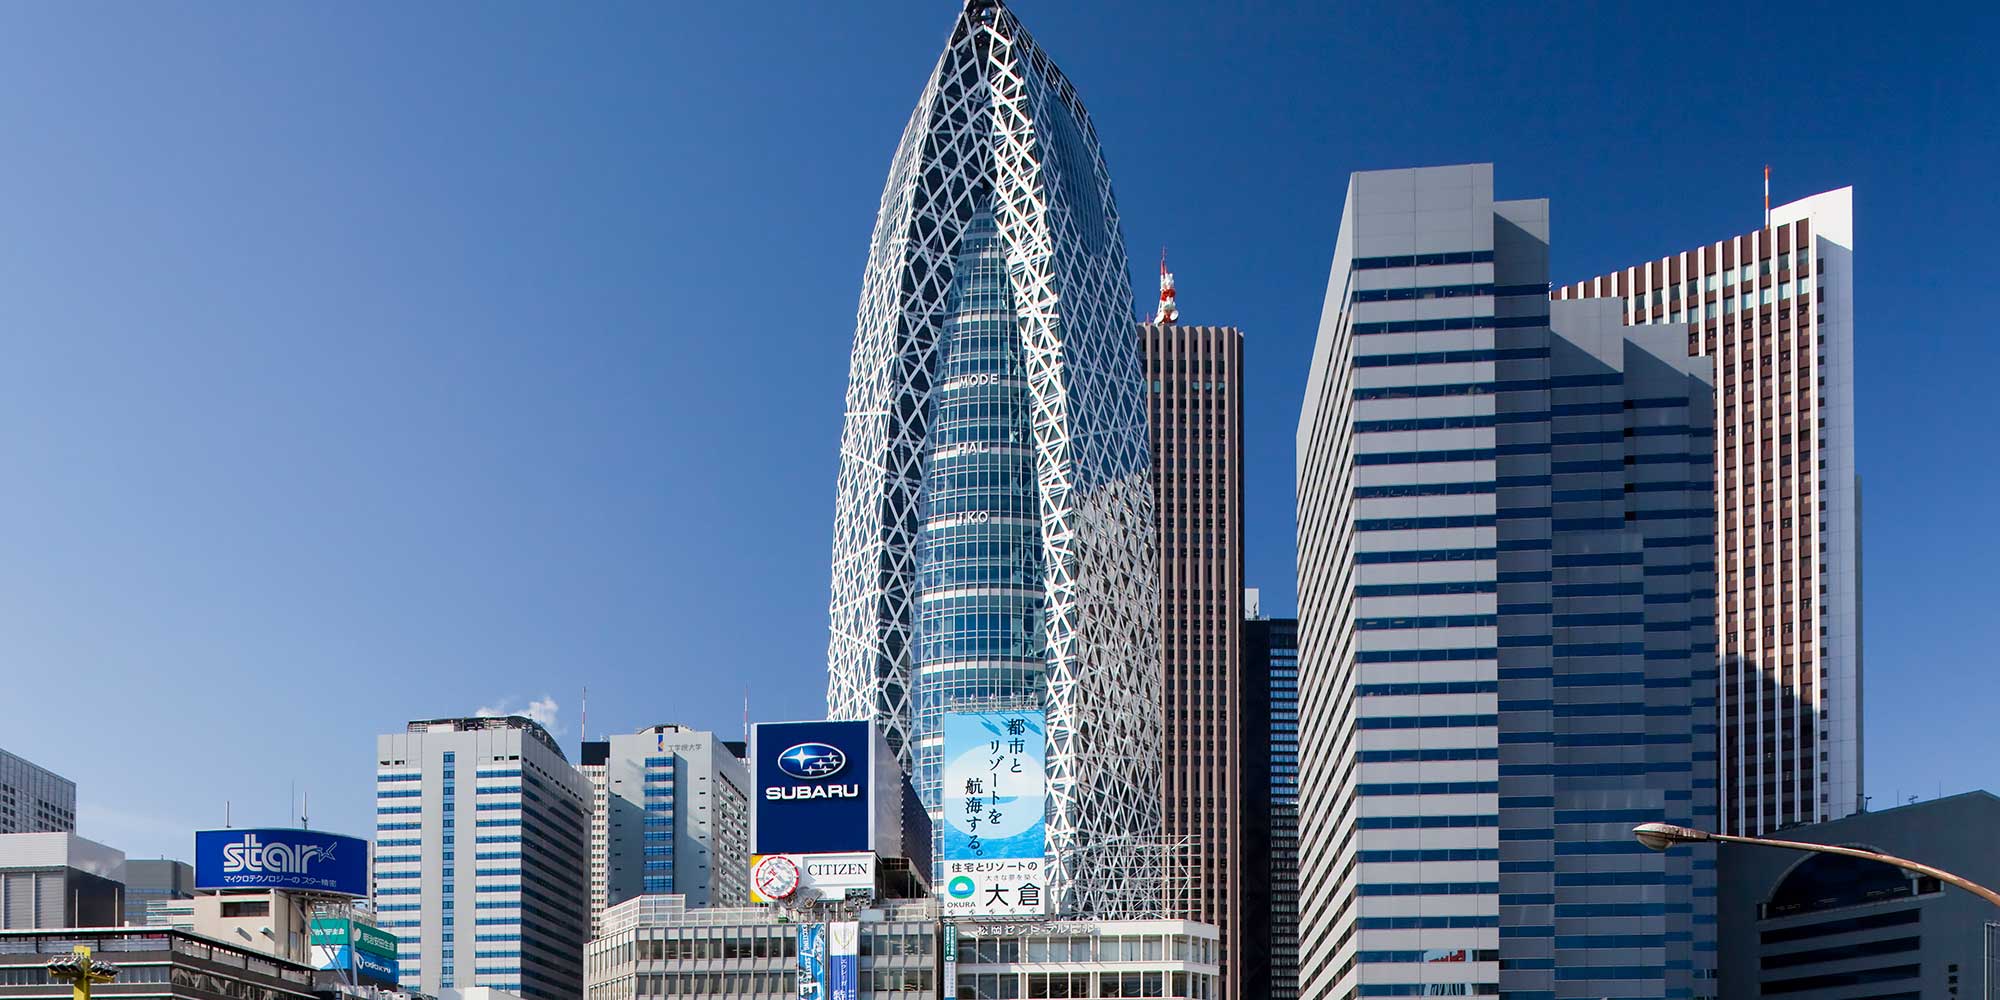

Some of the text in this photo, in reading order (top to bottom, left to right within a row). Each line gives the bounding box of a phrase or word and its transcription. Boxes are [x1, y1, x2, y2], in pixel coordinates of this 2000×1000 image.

[959, 373, 999, 388] MODE
[958, 441, 989, 456] HAL
[1008, 718, 1026, 773] 都市と
[765, 783, 859, 800] SUBARU
[988, 739, 1005, 825] リゾートを
[965, 777, 984, 857] 航海する。
[223, 833, 319, 874] star
[807, 862, 868, 877] CITIZEN
[984, 883, 1042, 907] 大倉
